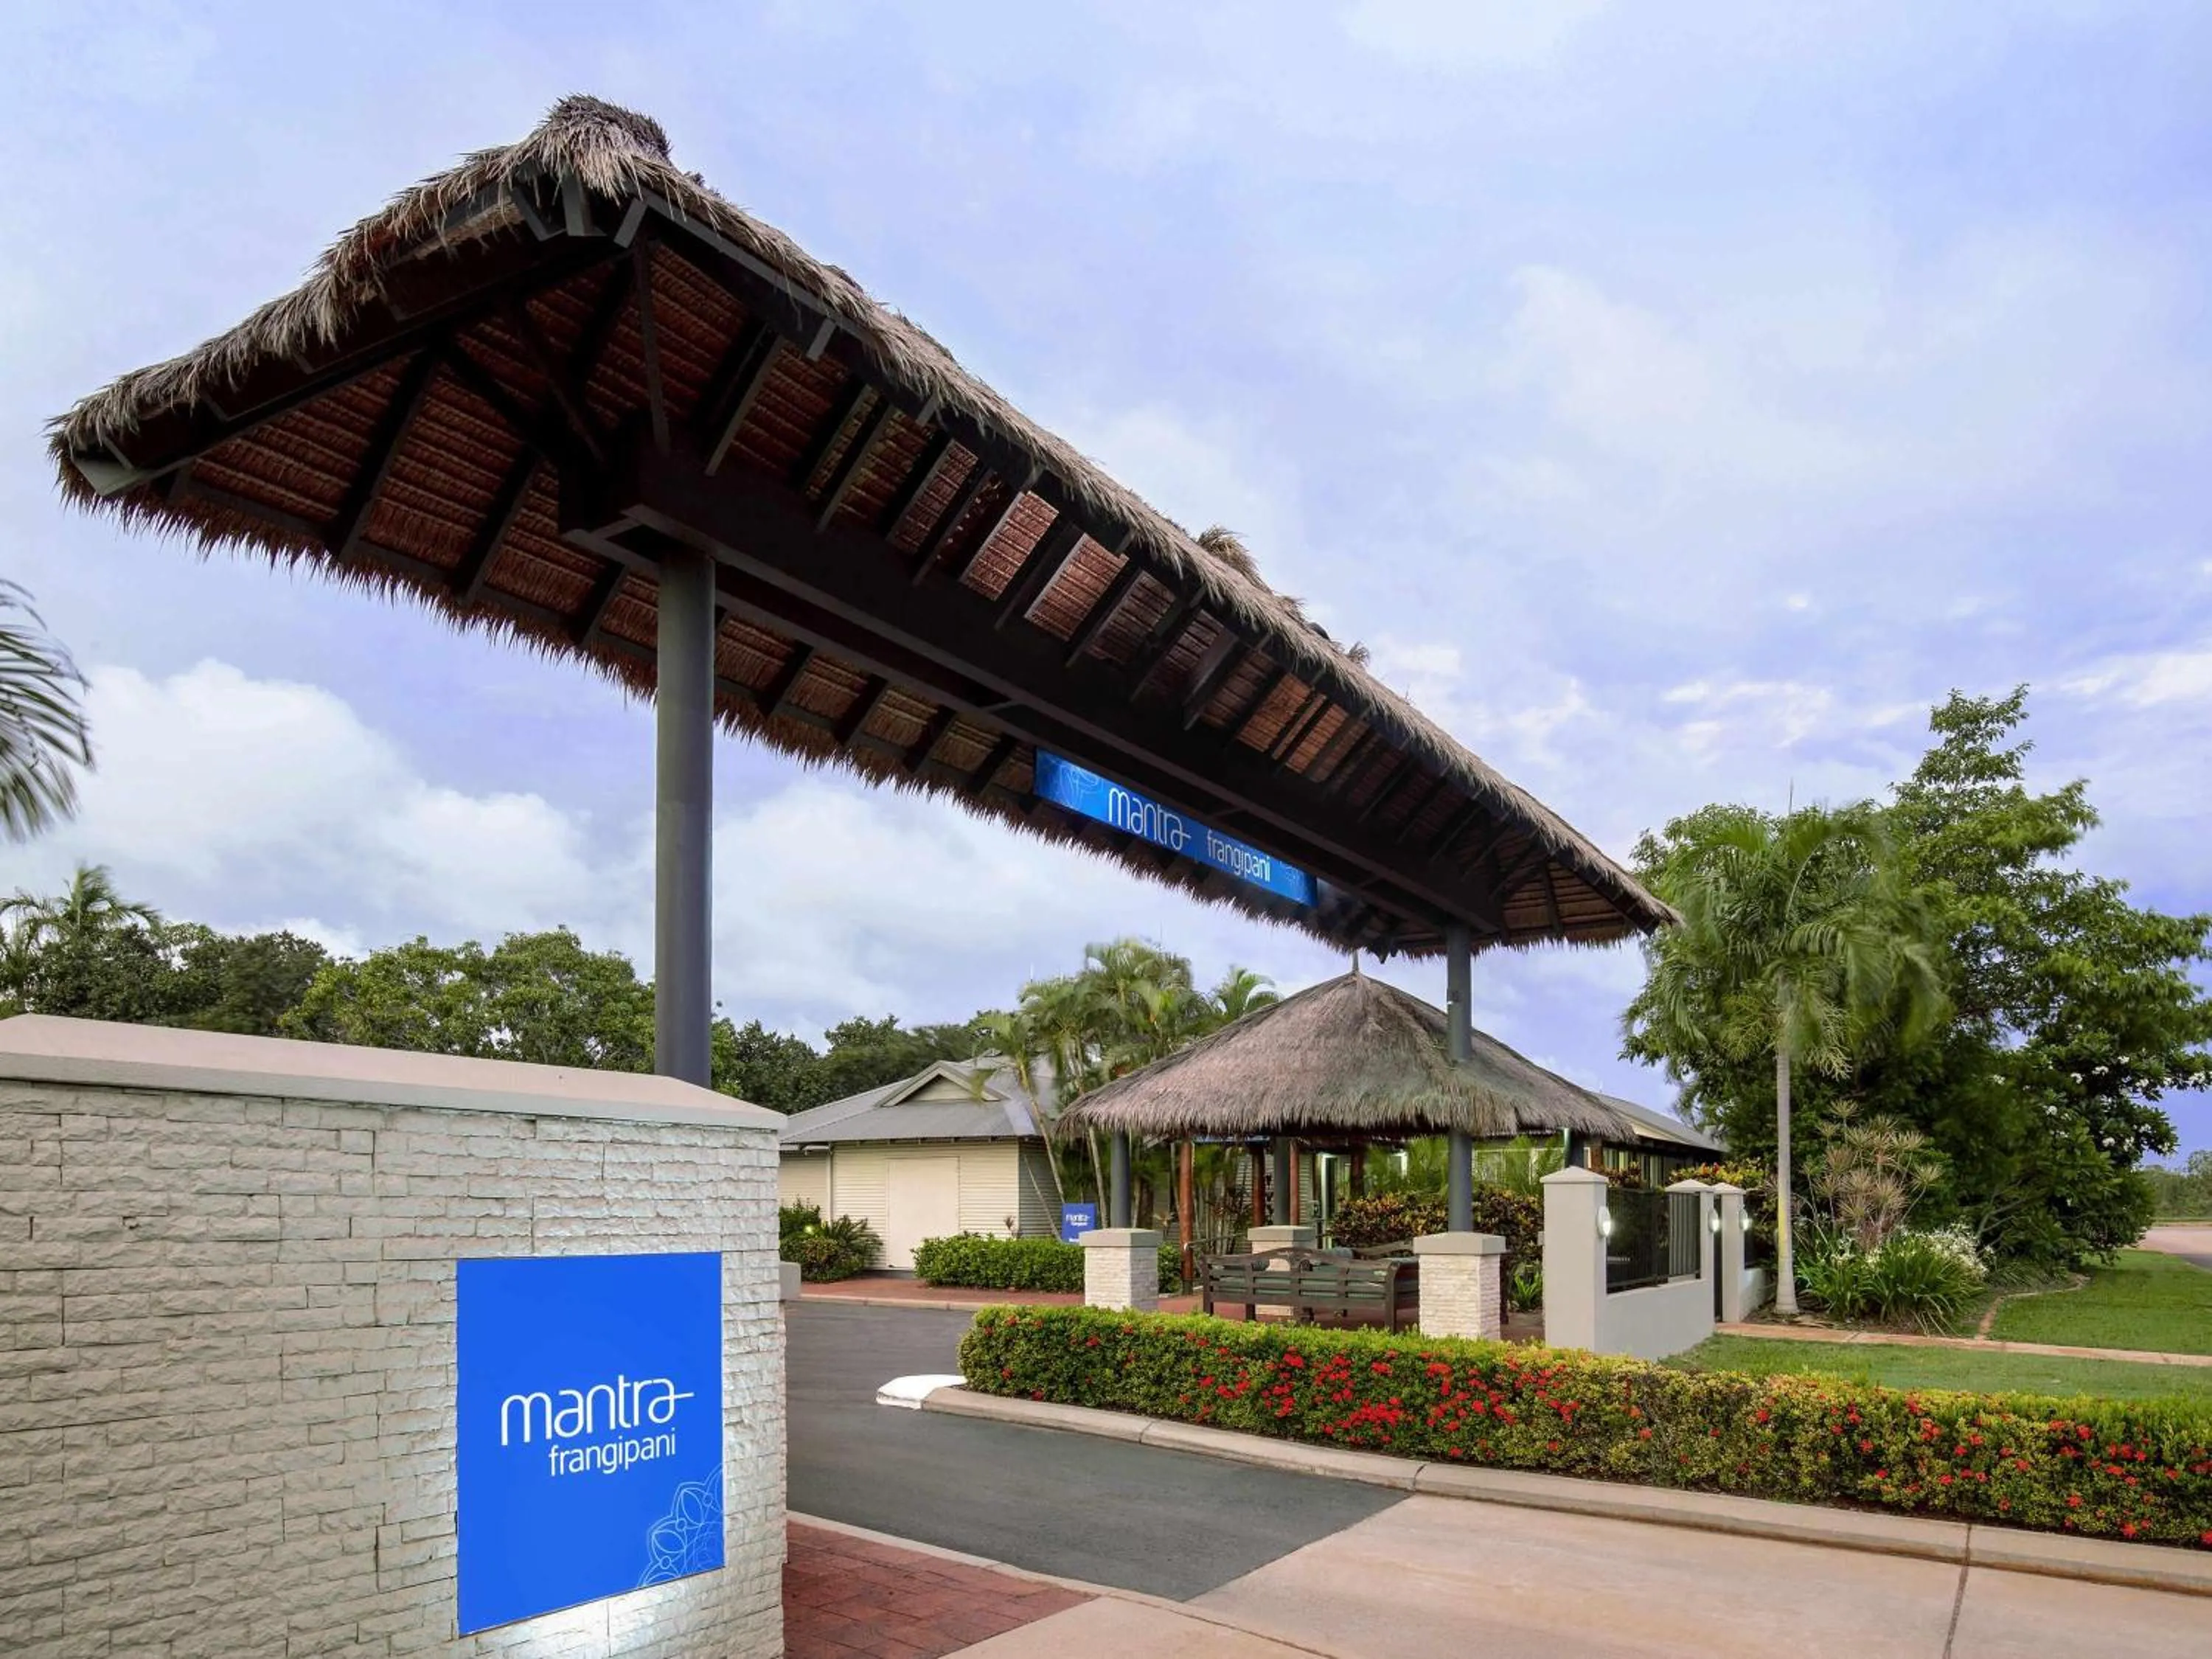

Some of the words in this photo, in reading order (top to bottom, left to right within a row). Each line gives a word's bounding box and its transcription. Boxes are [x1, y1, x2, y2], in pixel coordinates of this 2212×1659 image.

[1108, 788, 1191, 850] mantra
[1207, 830, 1270, 881] frangipani
[501, 1374, 695, 1446] mantra
[549, 1427, 676, 1476] frangipani
